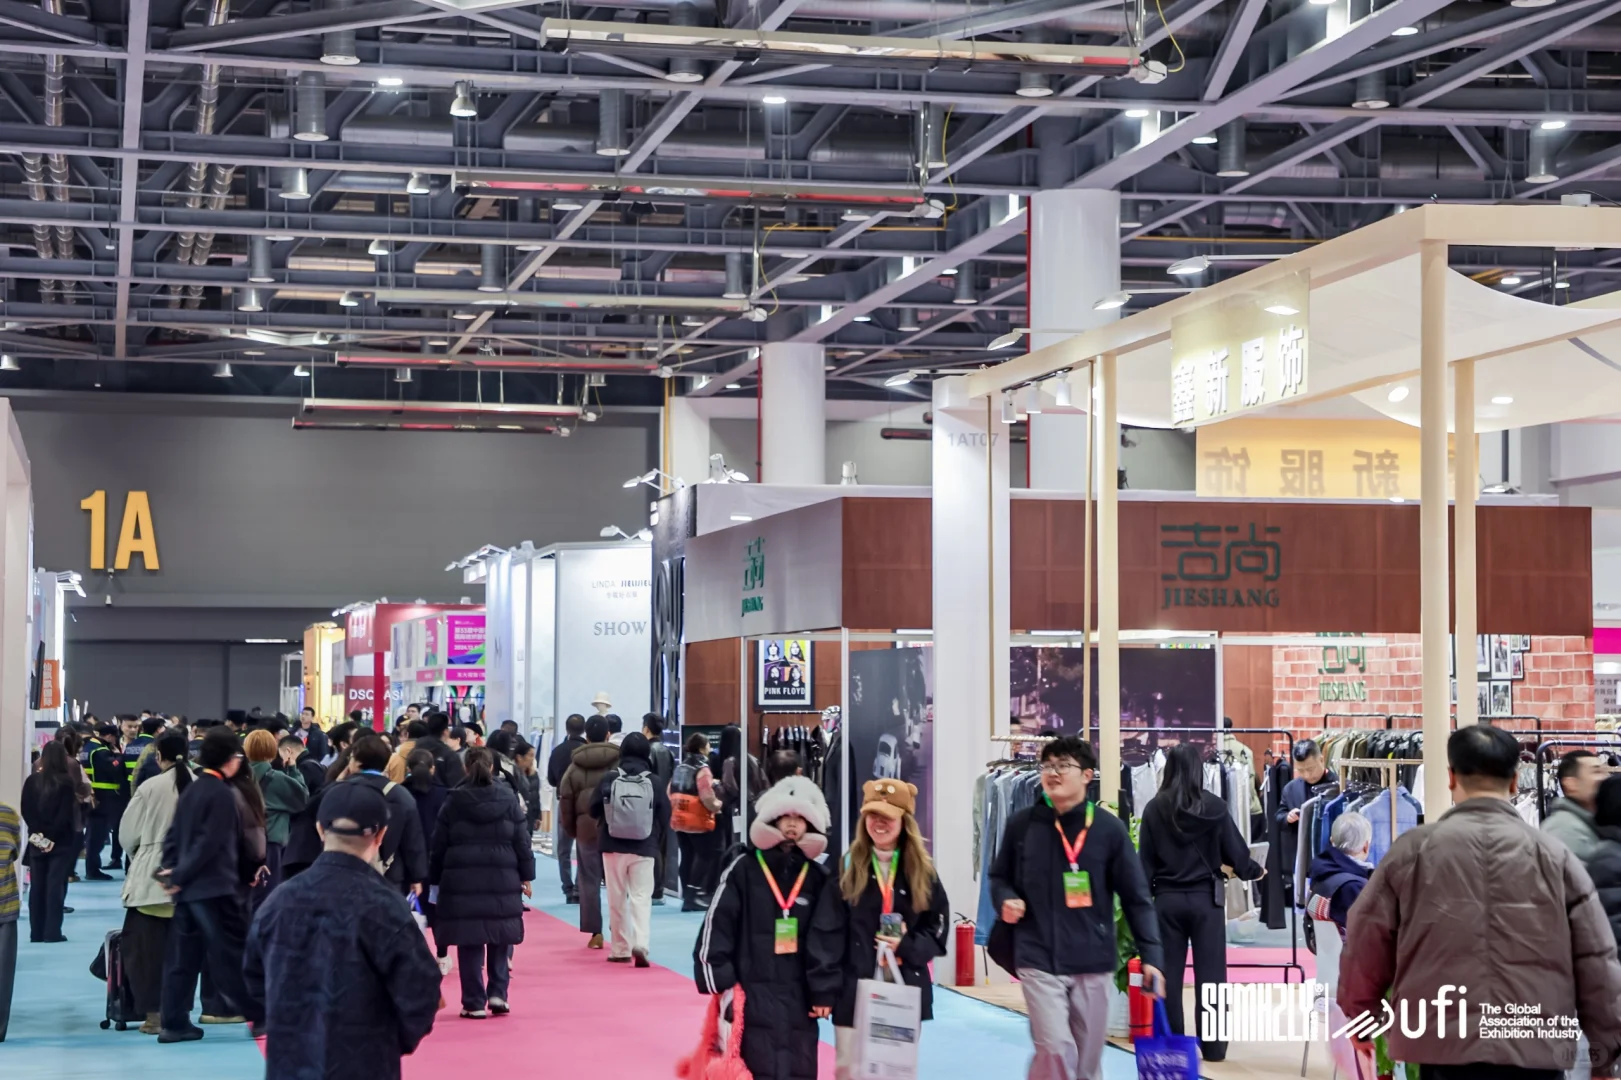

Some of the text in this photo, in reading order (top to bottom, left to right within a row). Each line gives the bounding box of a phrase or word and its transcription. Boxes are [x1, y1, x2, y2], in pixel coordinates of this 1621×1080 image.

[948, 432, 999, 447] 1AT07
[80, 490, 160, 571] 1A
[1161, 588, 1280, 610] JIESHANG
[593, 620, 647, 637] SHOW
[764, 687, 806, 695] PINK FLOYD
